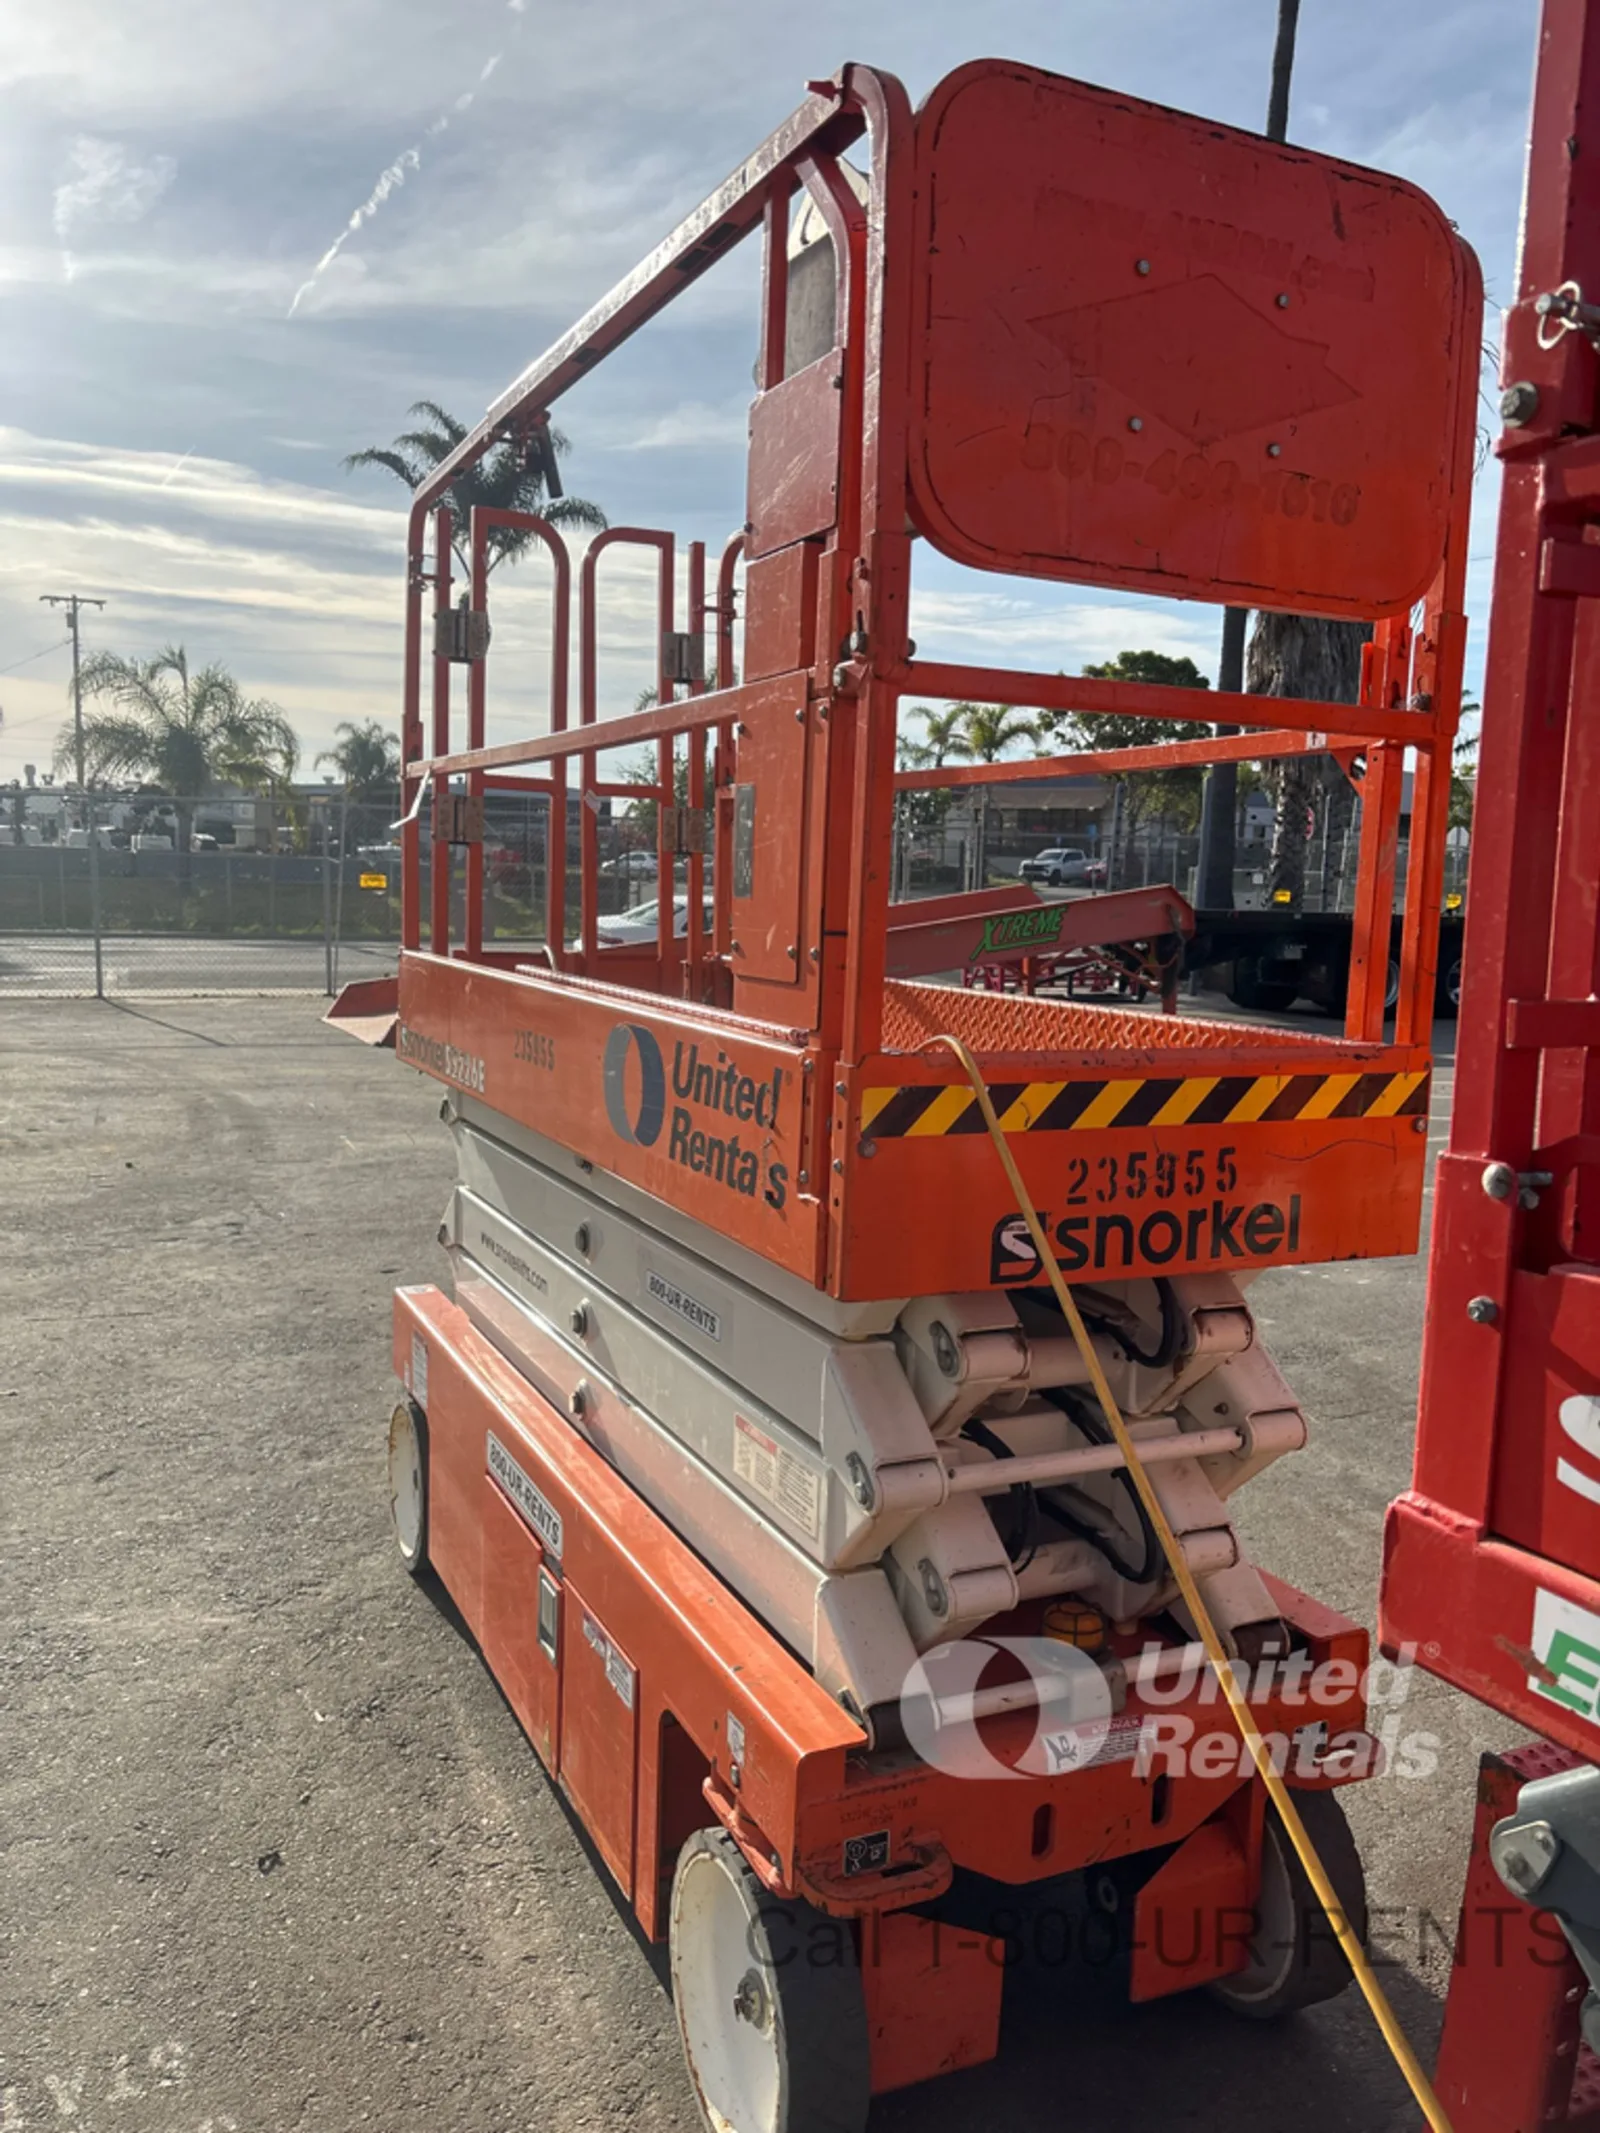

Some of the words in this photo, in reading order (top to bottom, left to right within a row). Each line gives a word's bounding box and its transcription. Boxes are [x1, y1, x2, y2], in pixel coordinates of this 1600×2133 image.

[969, 905, 1068, 961] XTREME
[672, 1040, 783, 1129] United
[669, 1106, 788, 1210] Rentas
[1067, 1147, 1237, 1204] 235955
[1056, 1194, 1302, 1272] snorkel
[650, 1276, 716, 1334] 800-UR-RENTS
[490, 1443, 560, 1546] 800-UR-RENTS
